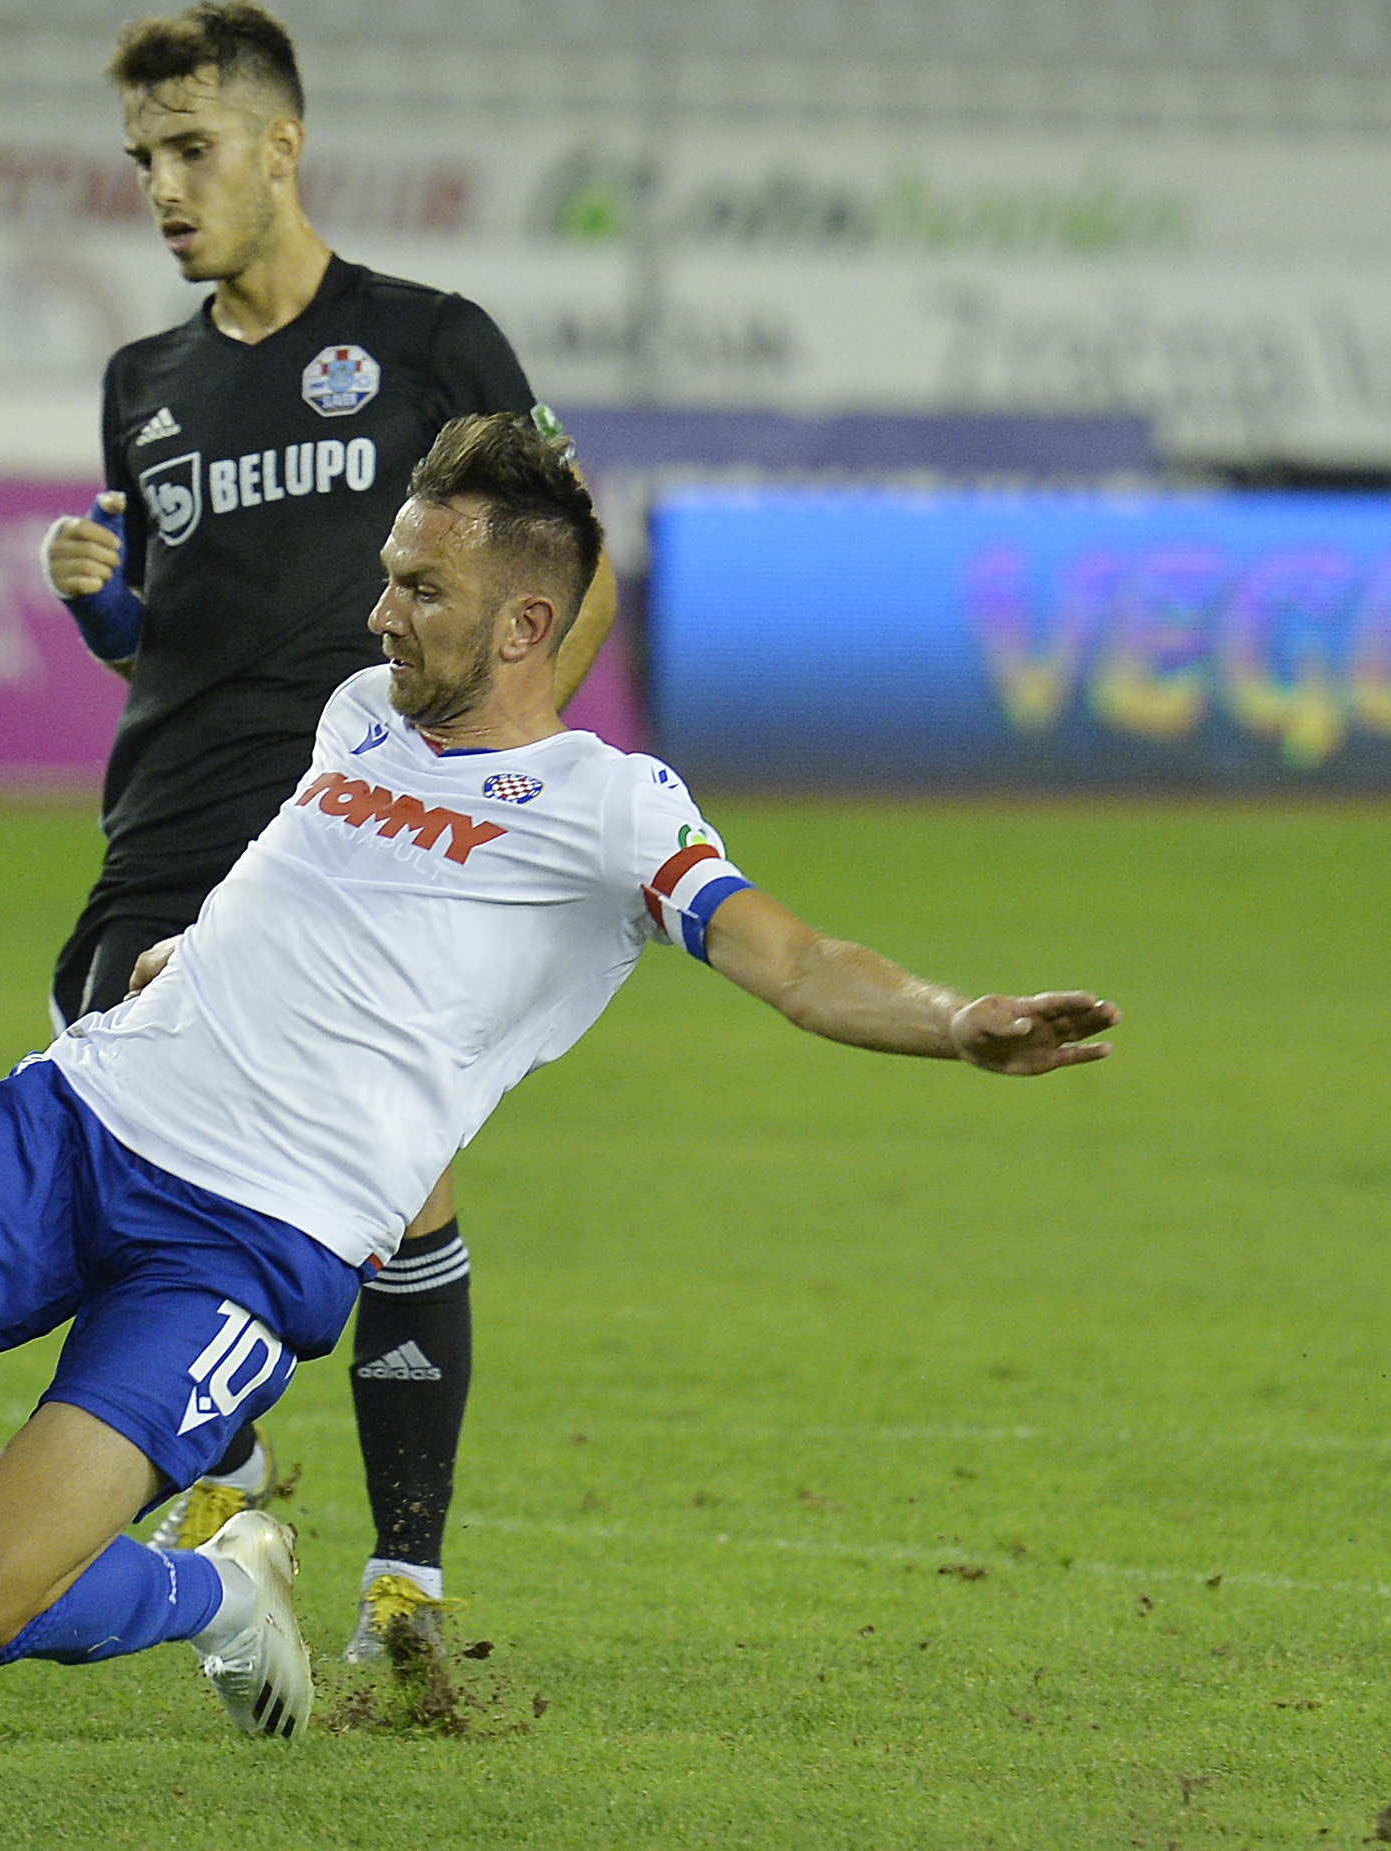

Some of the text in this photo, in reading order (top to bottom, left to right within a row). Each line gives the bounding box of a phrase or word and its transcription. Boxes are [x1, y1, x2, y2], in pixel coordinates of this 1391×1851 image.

[209, 437, 376, 514] BELUPO
[294, 771, 508, 865] TOMMY
[188, 1299, 283, 1418] 10
[358, 1366, 442, 1381] adidas
